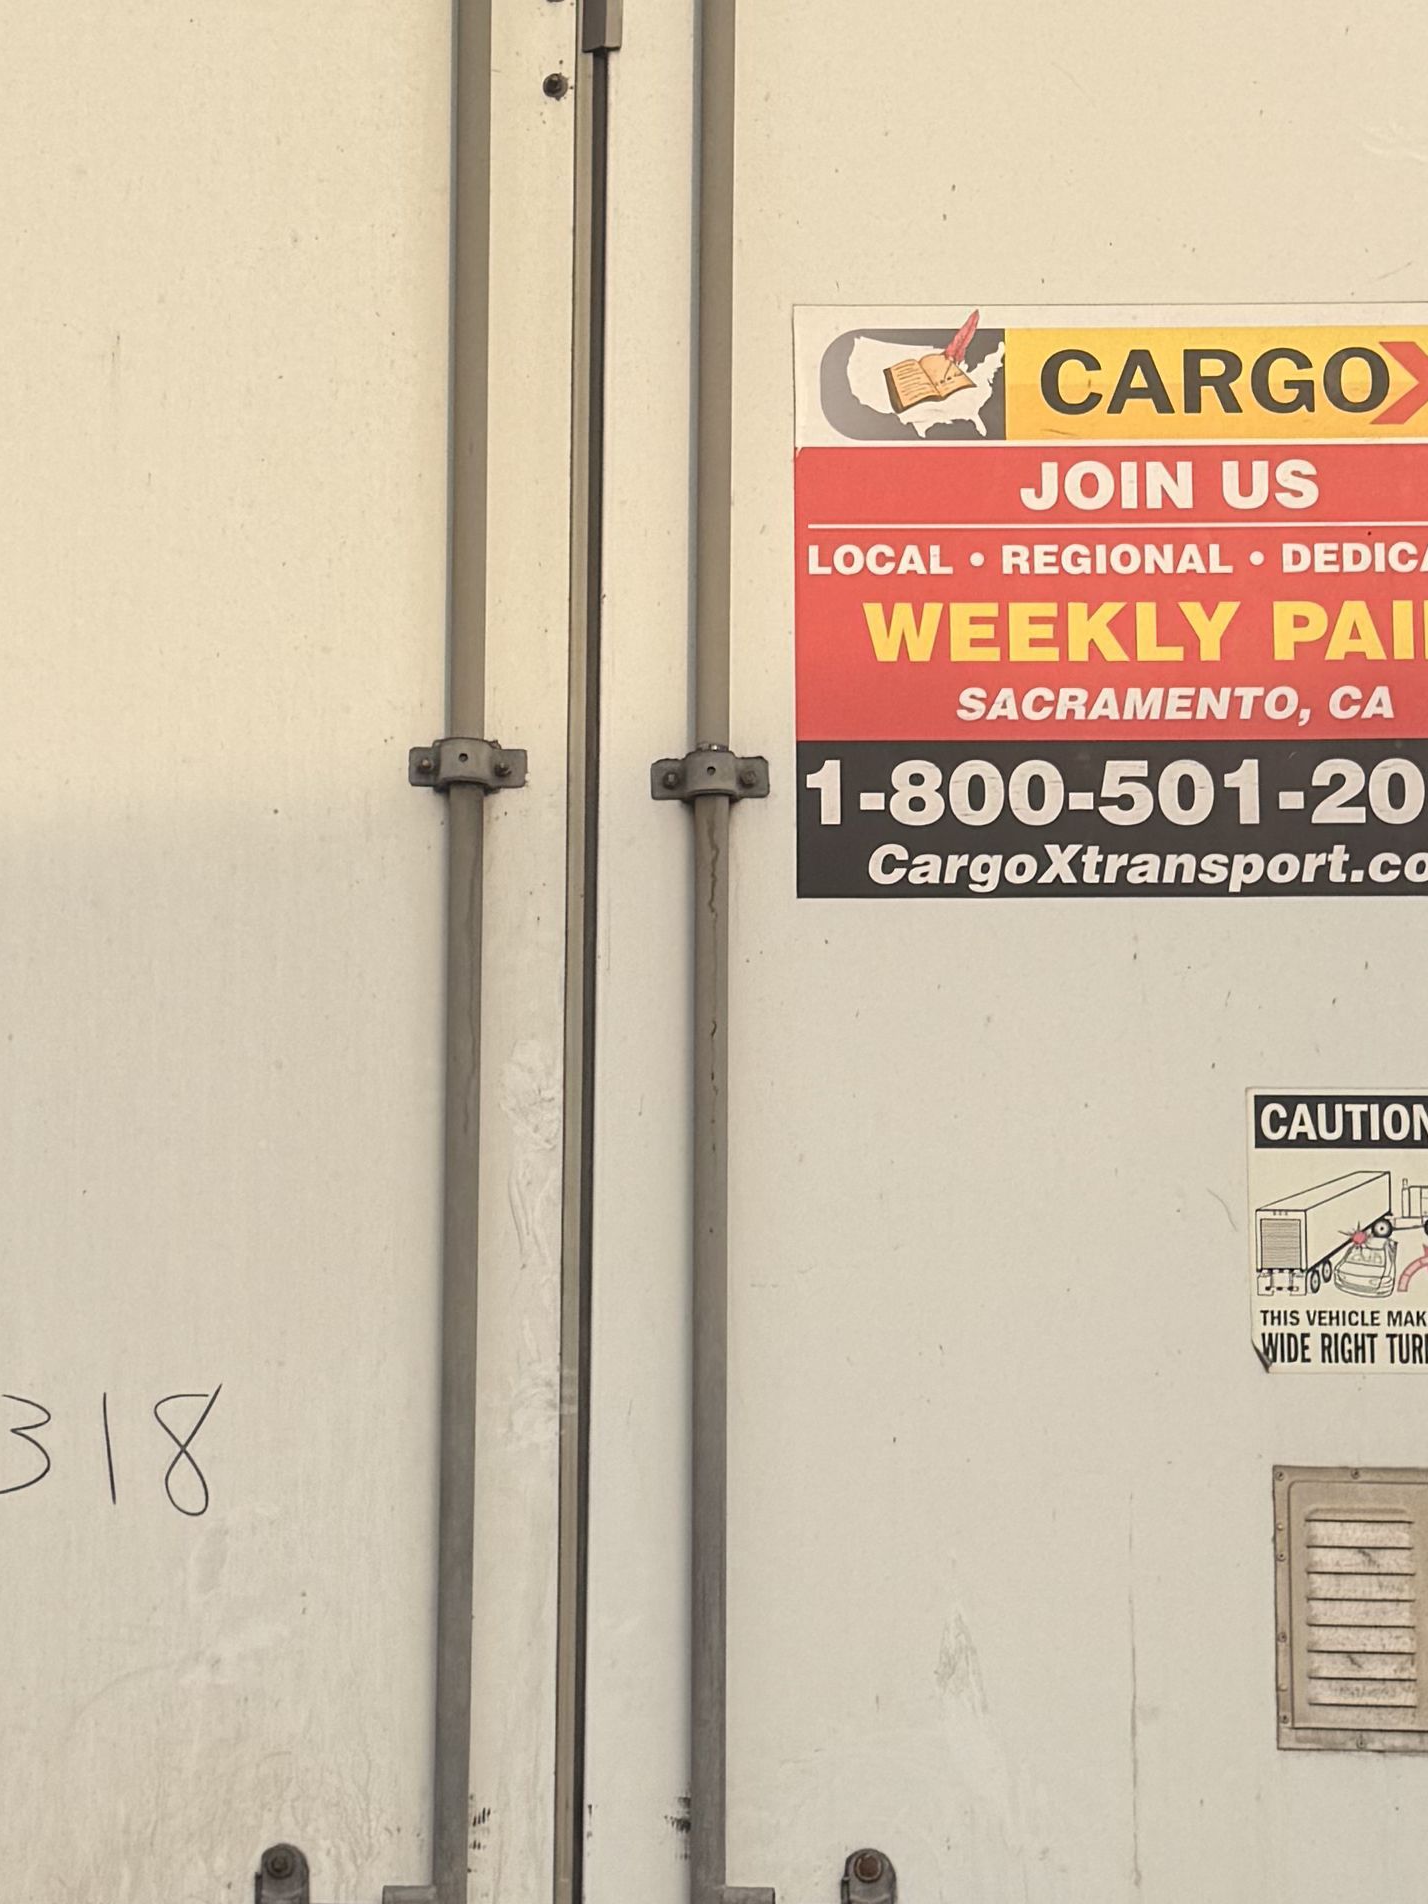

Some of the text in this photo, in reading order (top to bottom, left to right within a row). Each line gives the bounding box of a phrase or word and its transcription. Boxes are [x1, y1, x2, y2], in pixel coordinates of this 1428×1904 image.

[1020, 459, 1320, 511] JOIN US
[808, 545, 953, 576] LOCAL
[1002, 543, 1233, 575] REGIONAL
[863, 601, 1240, 663] WEEKLY
[956, 686, 1395, 727] SACRAMENTO, CA
[1260, 1309, 1300, 1327] THIS
[1306, 1310, 1381, 1327] VEHICLE
[1261, 1332, 1311, 1363] WIDE
[1321, 1333, 1378, 1364] RIGHT
